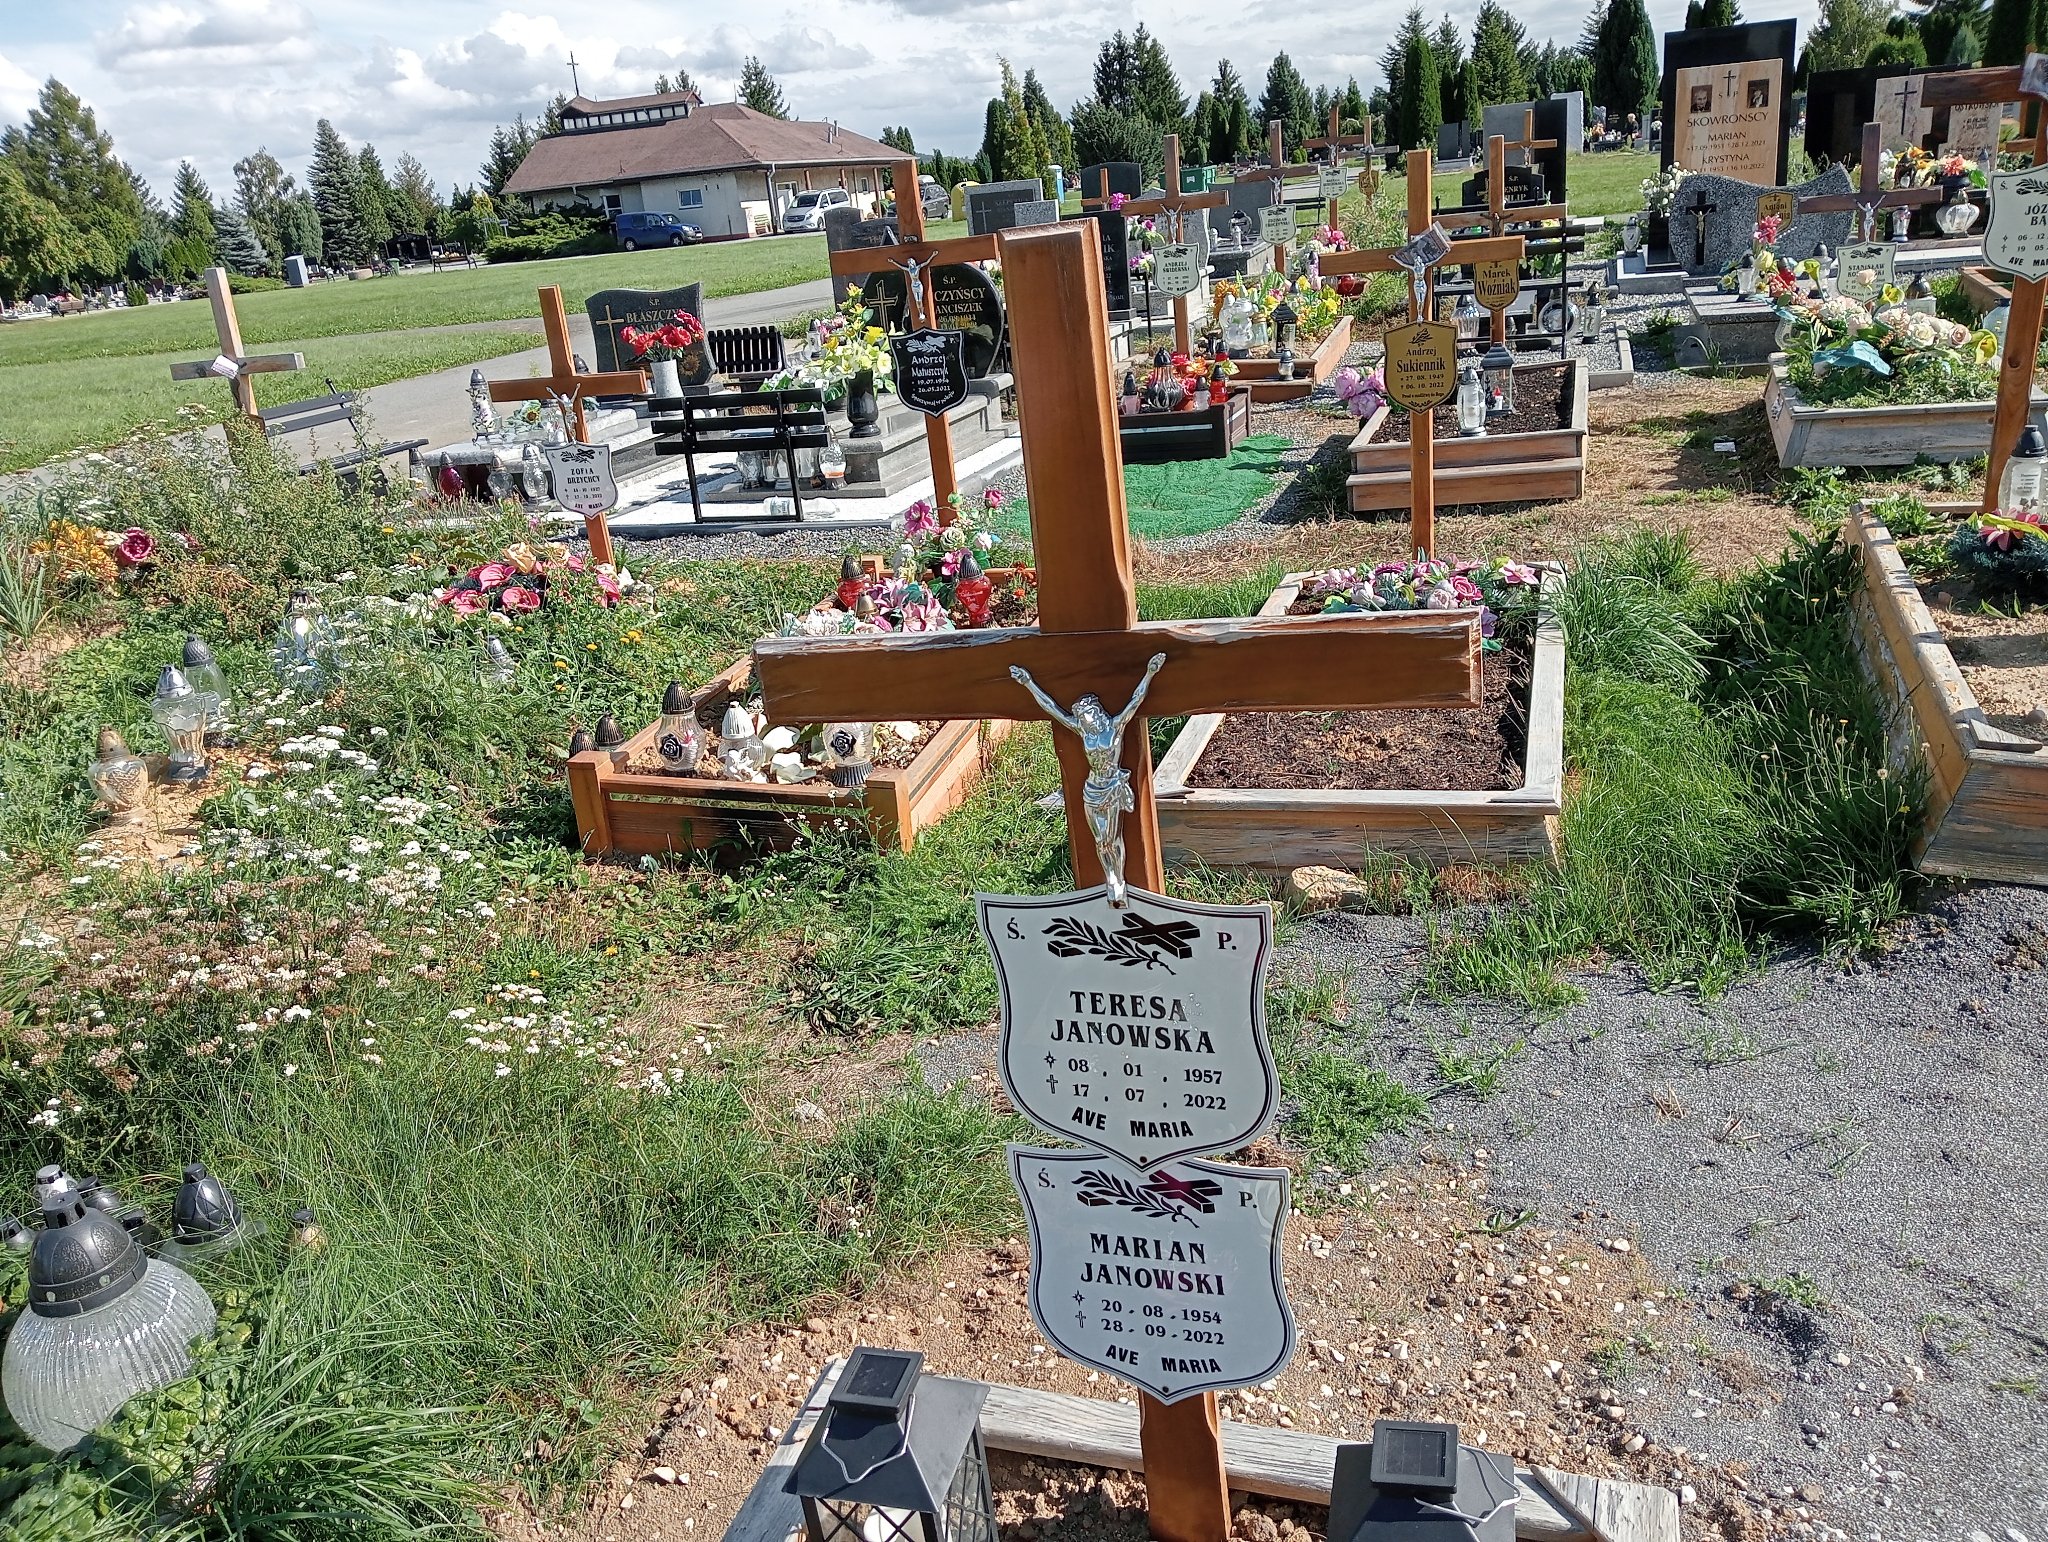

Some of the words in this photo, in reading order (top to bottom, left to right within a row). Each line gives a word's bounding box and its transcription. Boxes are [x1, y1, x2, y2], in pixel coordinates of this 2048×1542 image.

[1708, 132, 1747, 142] MARIAN
[1702, 153, 1750, 164] KRYSTYNA
[1504, 184, 1528, 193] ENRYK
[2024, 203, 2048, 216] JÓZ
[2008, 256, 2024, 266] AVE
[2032, 259, 2048, 267] MA
[1482, 268, 1511, 279] Marek
[934, 287, 986, 302] CZYŃSCY
[1478, 278, 1516, 296] Woźniak
[935, 303, 983, 316] ANCISZEK
[1406, 346, 1437, 356] Andrzej
[912, 354, 946, 370] Andrzej
[1397, 357, 1446, 373] Sukiennik
[1006, 917, 1026, 940] Ś.
[1216, 932, 1237, 950] P.
[1070, 990, 1188, 1022] TERESA
[1050, 1019, 1216, 1054] JANOWSKA
[1183, 1068, 1223, 1084] 1957
[1183, 1094, 1228, 1111] 2022
[1072, 1106, 1107, 1131] AVE
[1130, 1120, 1194, 1138] MARIA
[1038, 1168, 1056, 1189] Ś.
[1238, 1190, 1258, 1209] P.
[1090, 1232, 1206, 1265] MARIAN
[1080, 1262, 1226, 1296] JANOWSKI
[1105, 1344, 1139, 1366] AVE
[1160, 1356, 1222, 1374] MARIA
